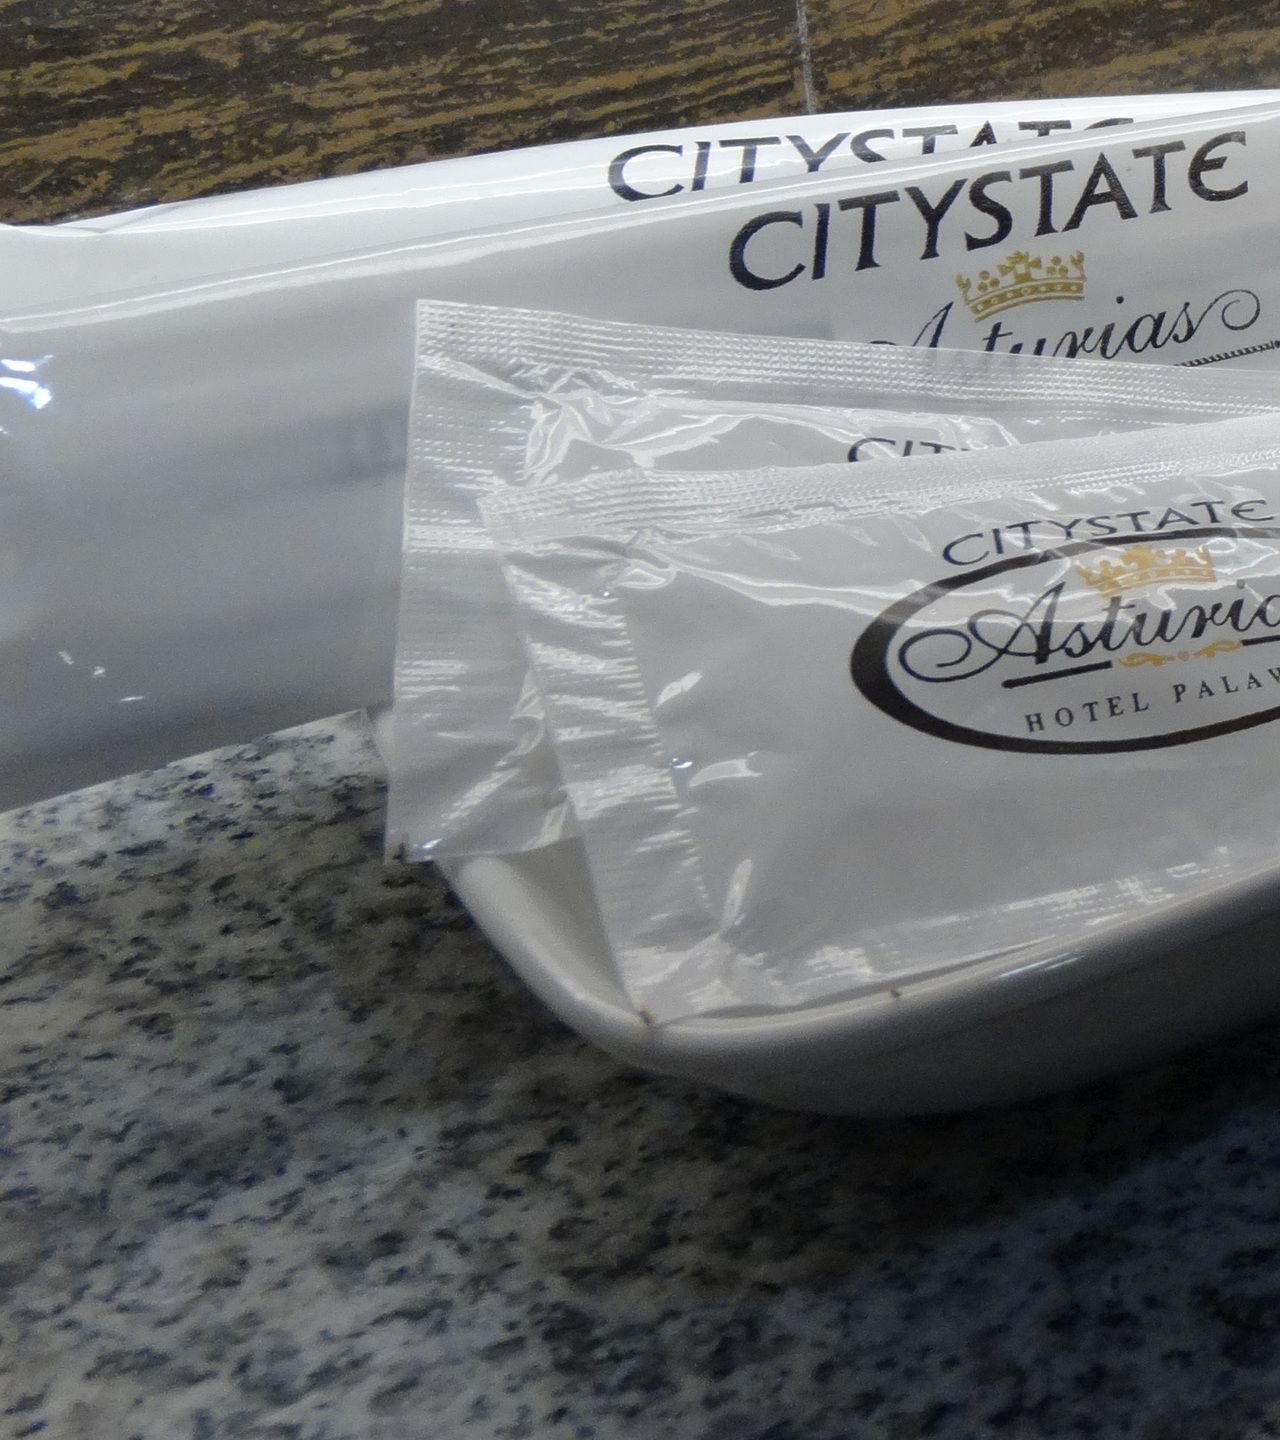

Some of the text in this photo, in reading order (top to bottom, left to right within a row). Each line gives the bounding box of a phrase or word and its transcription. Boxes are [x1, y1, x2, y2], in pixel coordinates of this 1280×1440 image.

[608, 117, 1135, 202] CITYST
[728, 131, 1249, 291] CITYSTATE
[941, 498, 1275, 566] CITYSTATE
[1024, 692, 1149, 733] HOTEL
